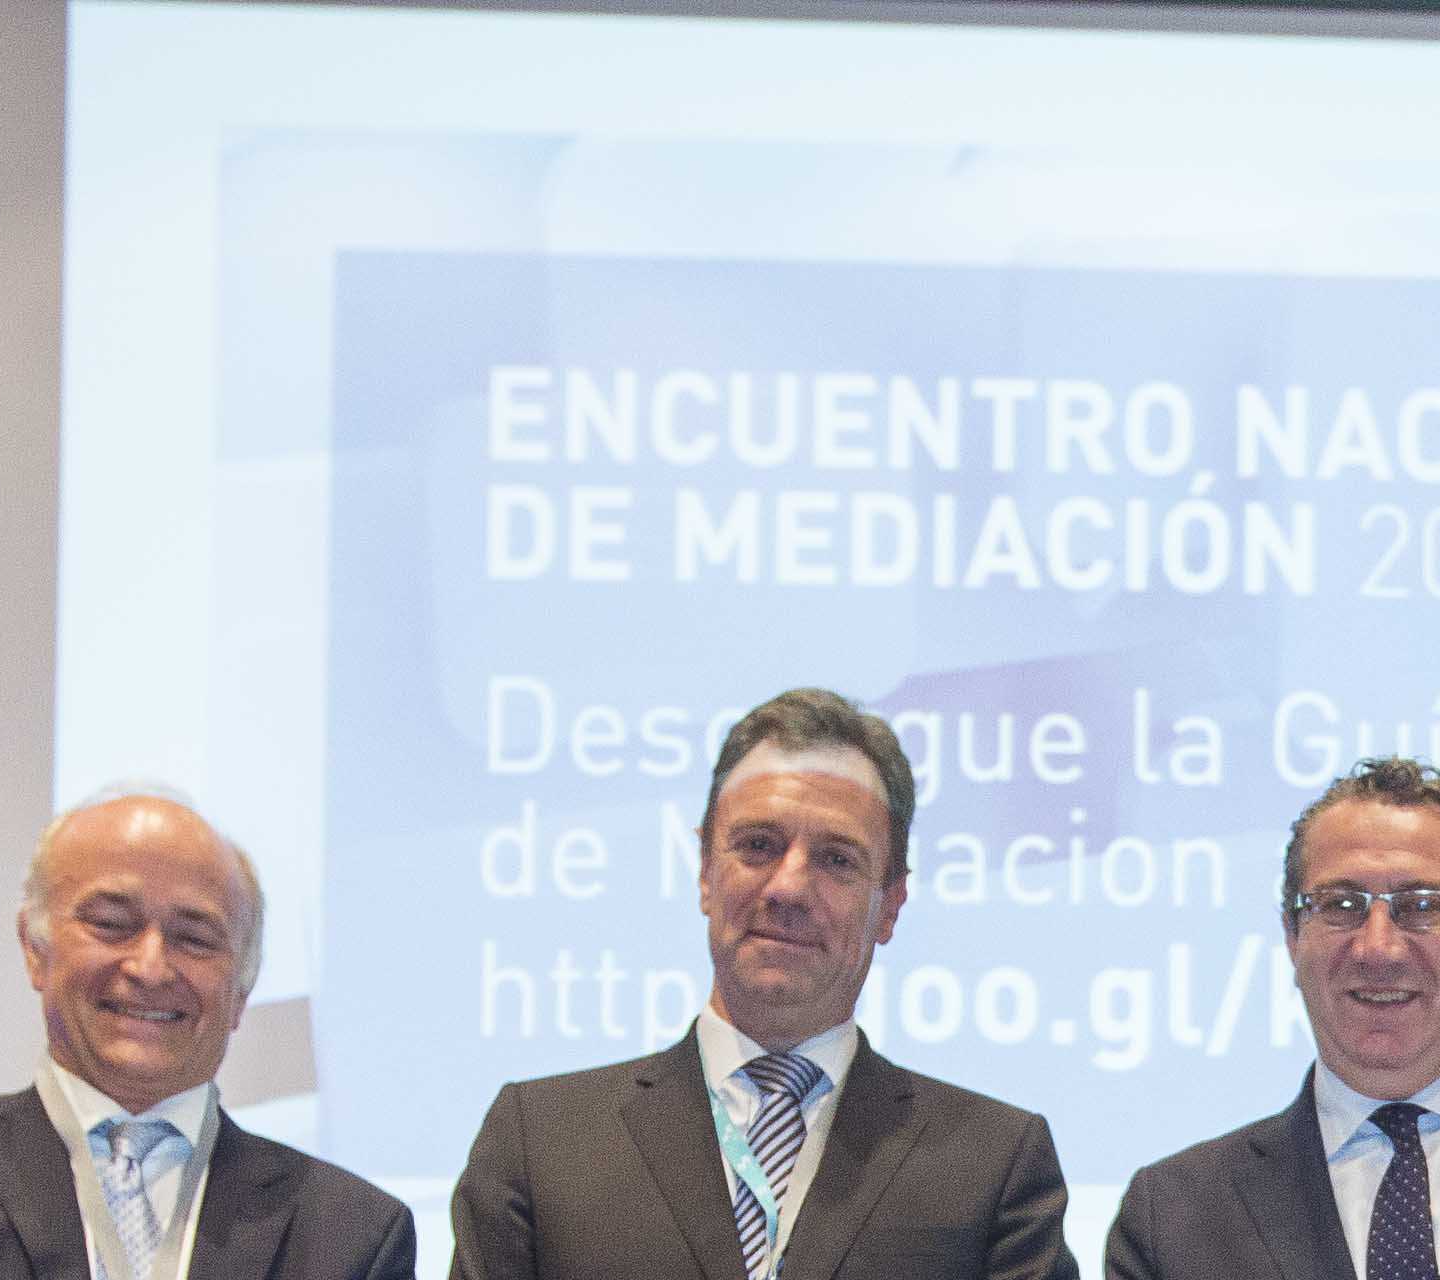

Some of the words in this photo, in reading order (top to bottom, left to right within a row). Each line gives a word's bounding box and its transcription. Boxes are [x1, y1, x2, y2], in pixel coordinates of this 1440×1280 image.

[488, 364, 1195, 477] ENCUENTRO
[486, 483, 634, 582] DE
[673, 468, 1317, 597] MEDIACIÓN
[487, 674, 1086, 808] Desgue
[1133, 686, 1223, 788] la
[479, 799, 608, 900] de
